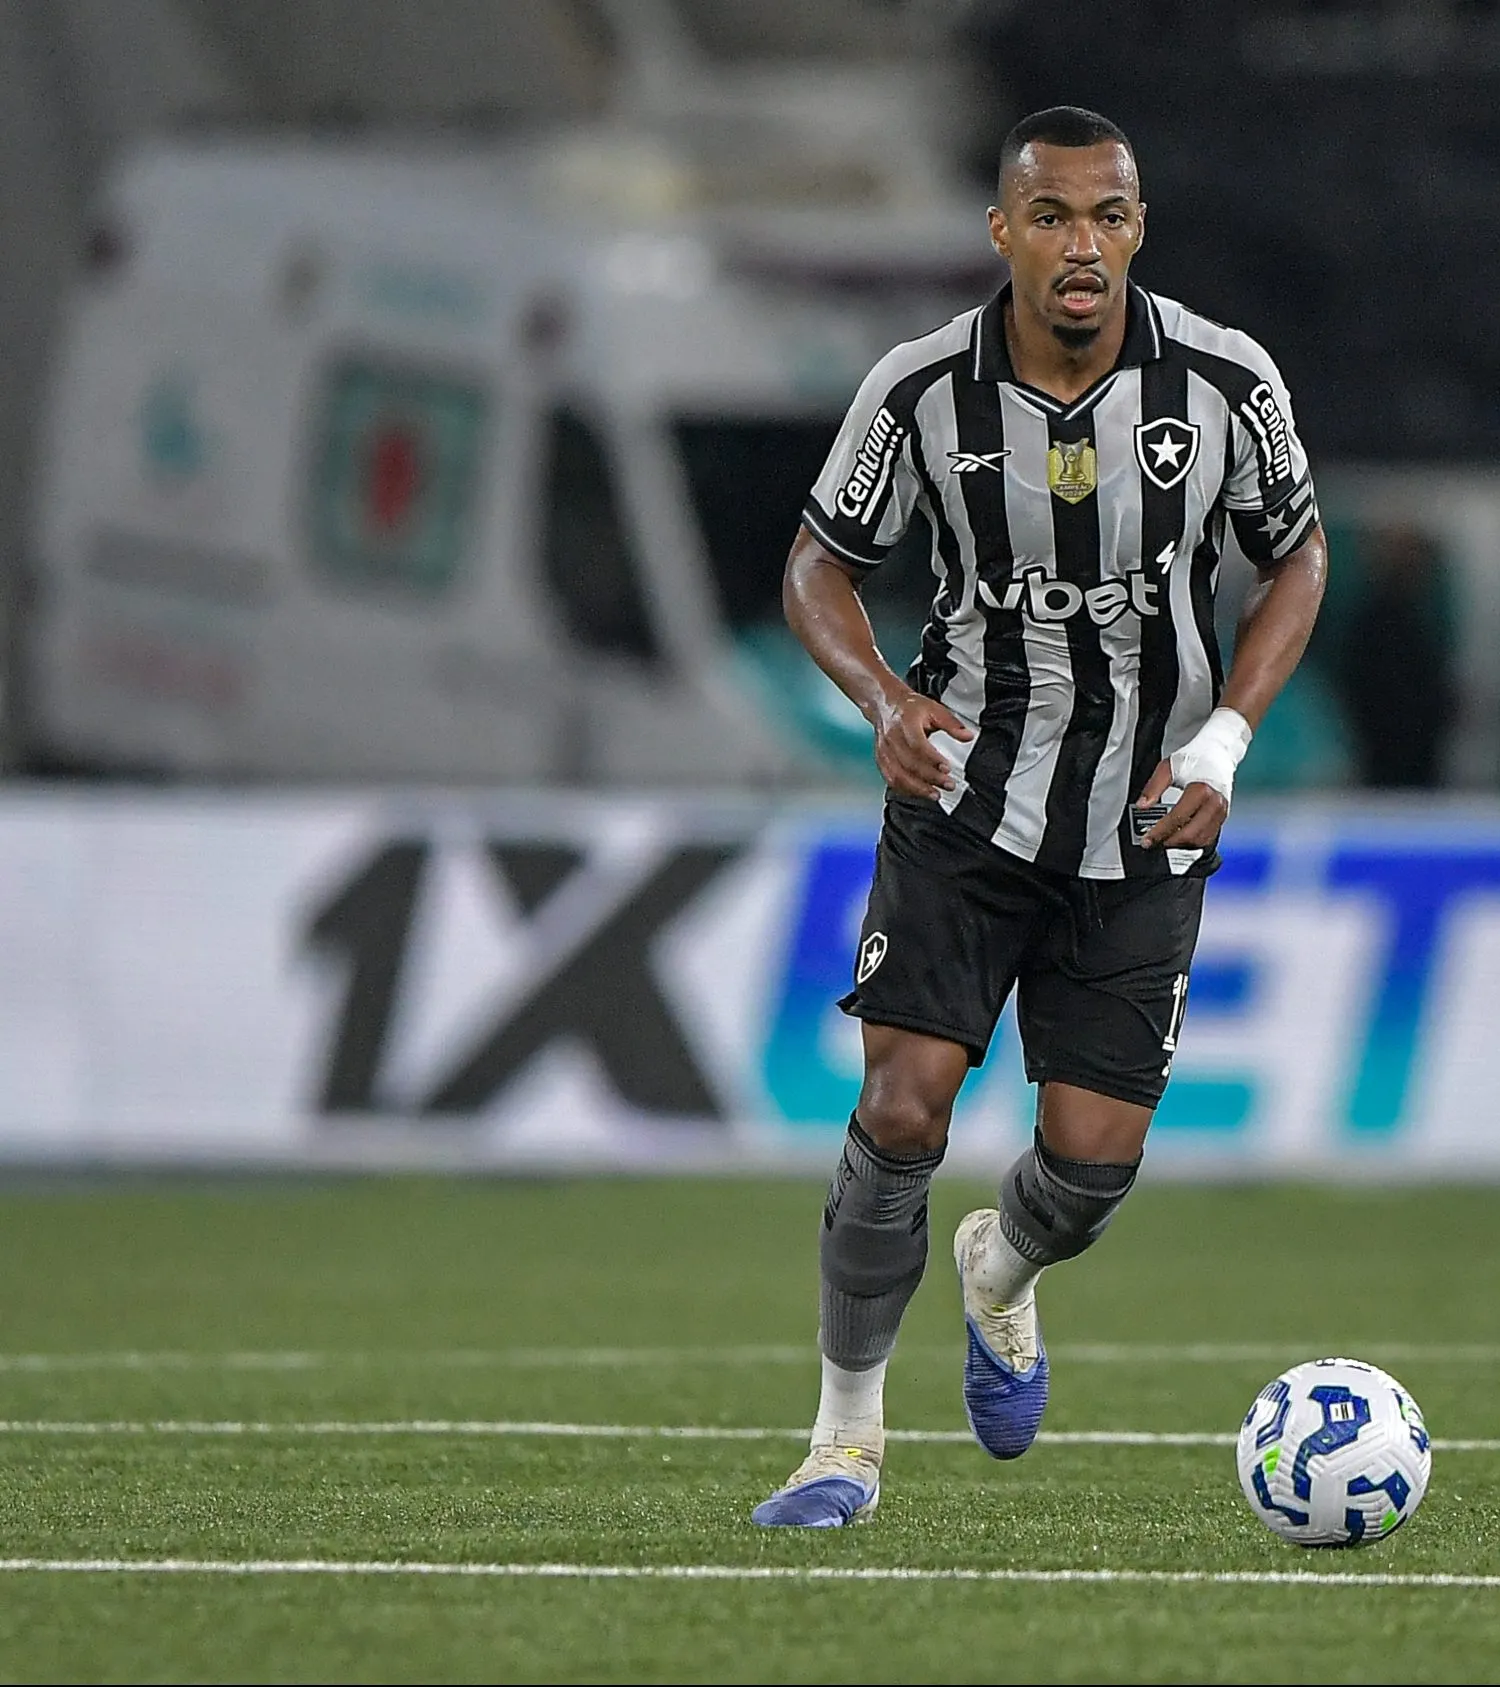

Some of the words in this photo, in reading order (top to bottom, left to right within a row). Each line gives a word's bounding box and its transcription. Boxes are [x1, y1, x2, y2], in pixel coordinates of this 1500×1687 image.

[836, 407, 897, 518] Centrum
[1250, 381, 1291, 482] Centrum
[978, 570, 1160, 625] vbet
[1162, 973, 1188, 1051] 1
